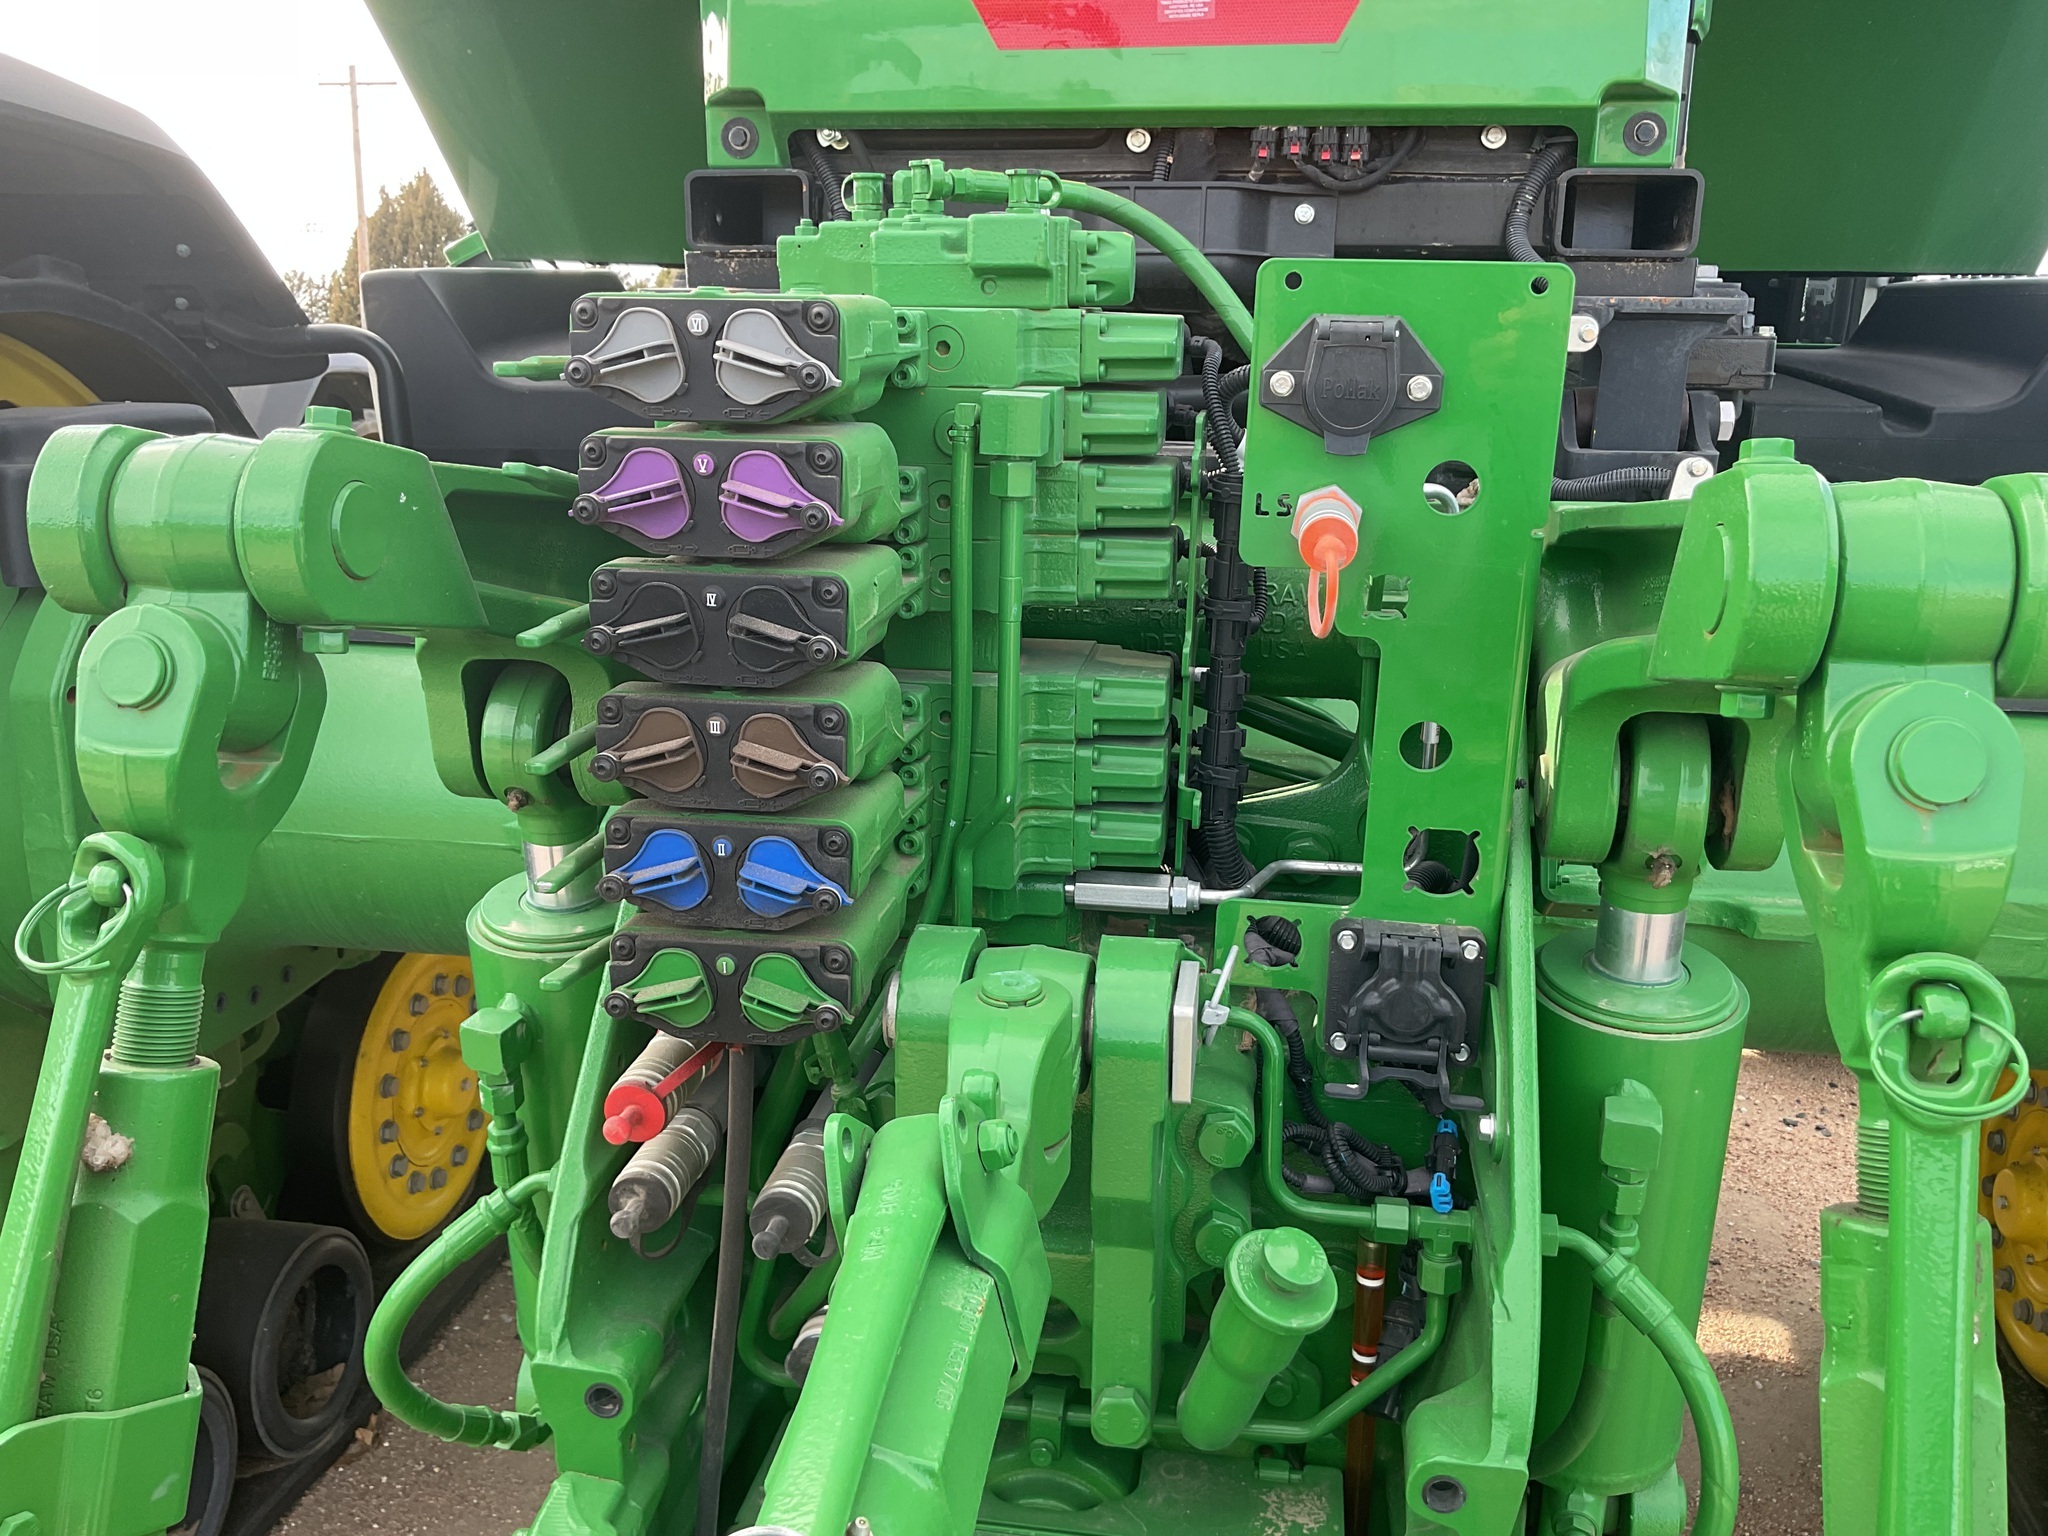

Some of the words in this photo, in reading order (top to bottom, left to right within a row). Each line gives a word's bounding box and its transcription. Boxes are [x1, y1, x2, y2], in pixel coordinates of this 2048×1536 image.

[691, 319, 703, 333] VI
[1320, 377, 1381, 401] Pollak
[697, 458, 708, 473] V
[706, 593, 717, 607] IV
[709, 720, 722, 734] III
[717, 843, 726, 856] II
